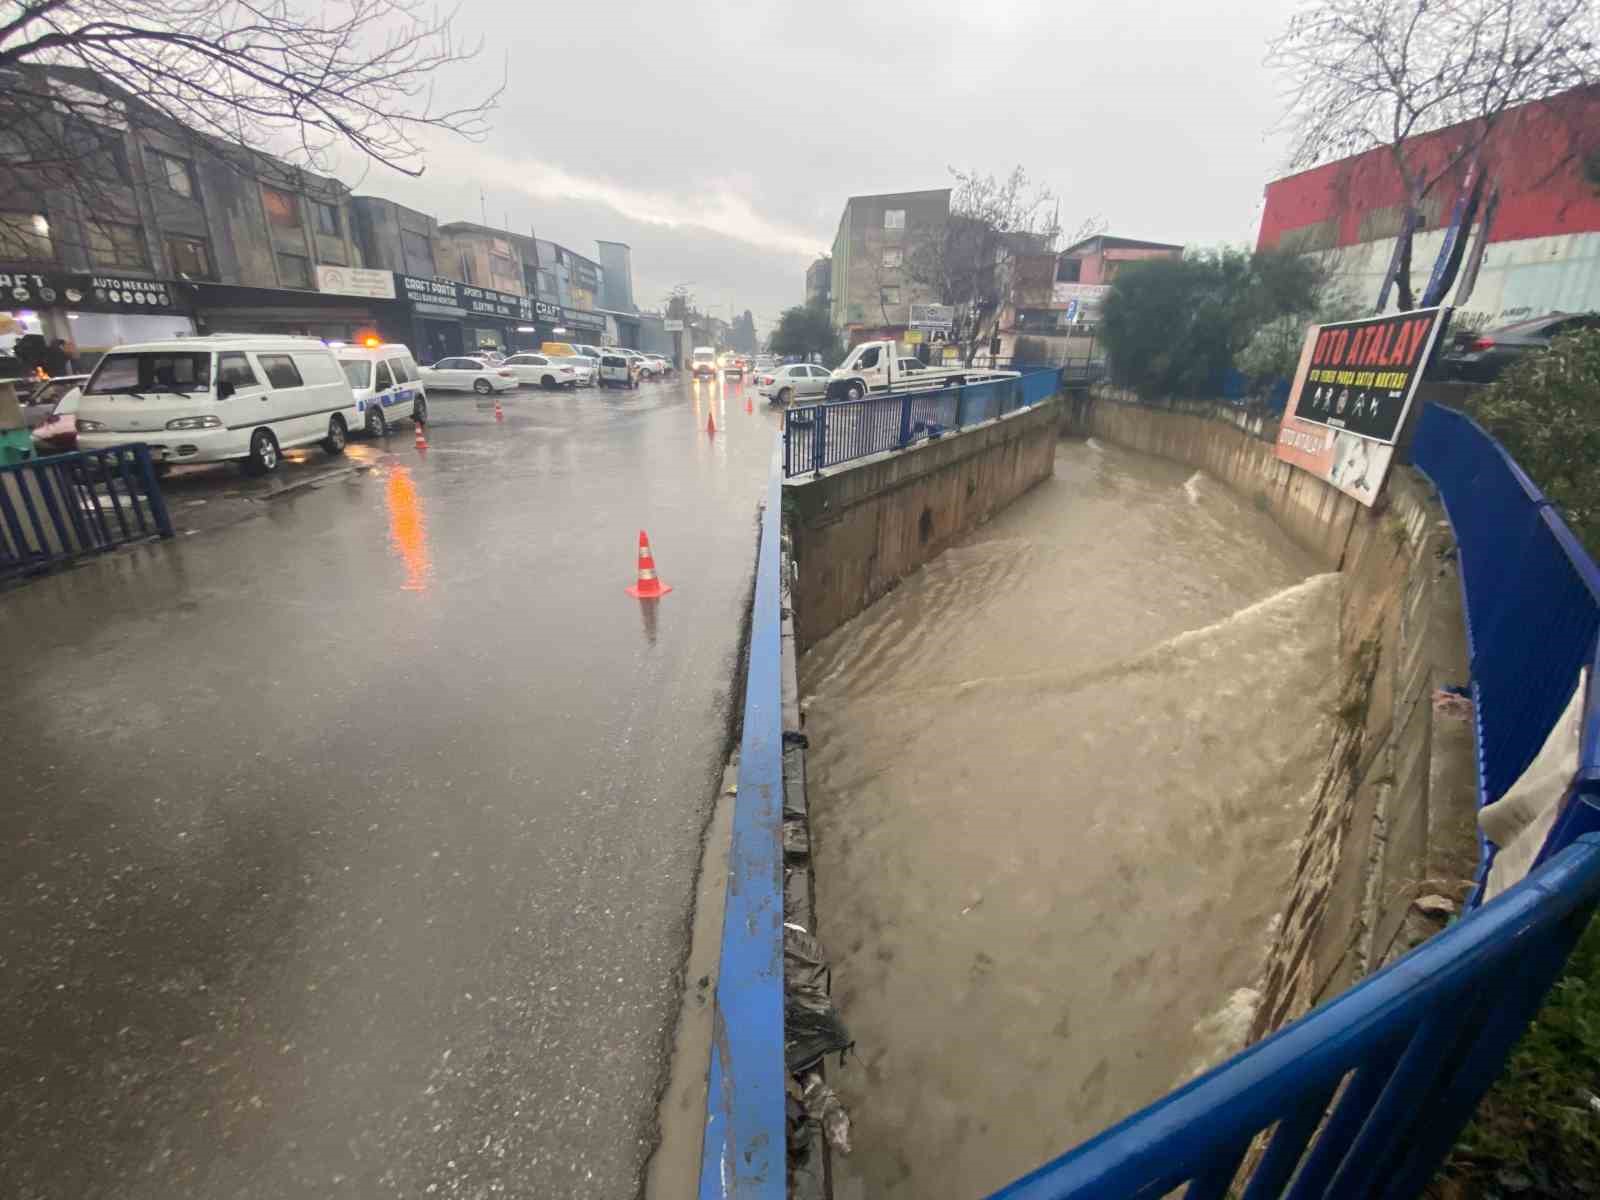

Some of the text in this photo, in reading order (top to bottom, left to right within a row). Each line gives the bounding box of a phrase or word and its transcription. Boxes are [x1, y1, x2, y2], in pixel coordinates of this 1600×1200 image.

[93, 278, 120, 288] AUTO
[536, 302, 560, 317] CRAFT
[1313, 318, 1431, 366] OTO ATALAY
